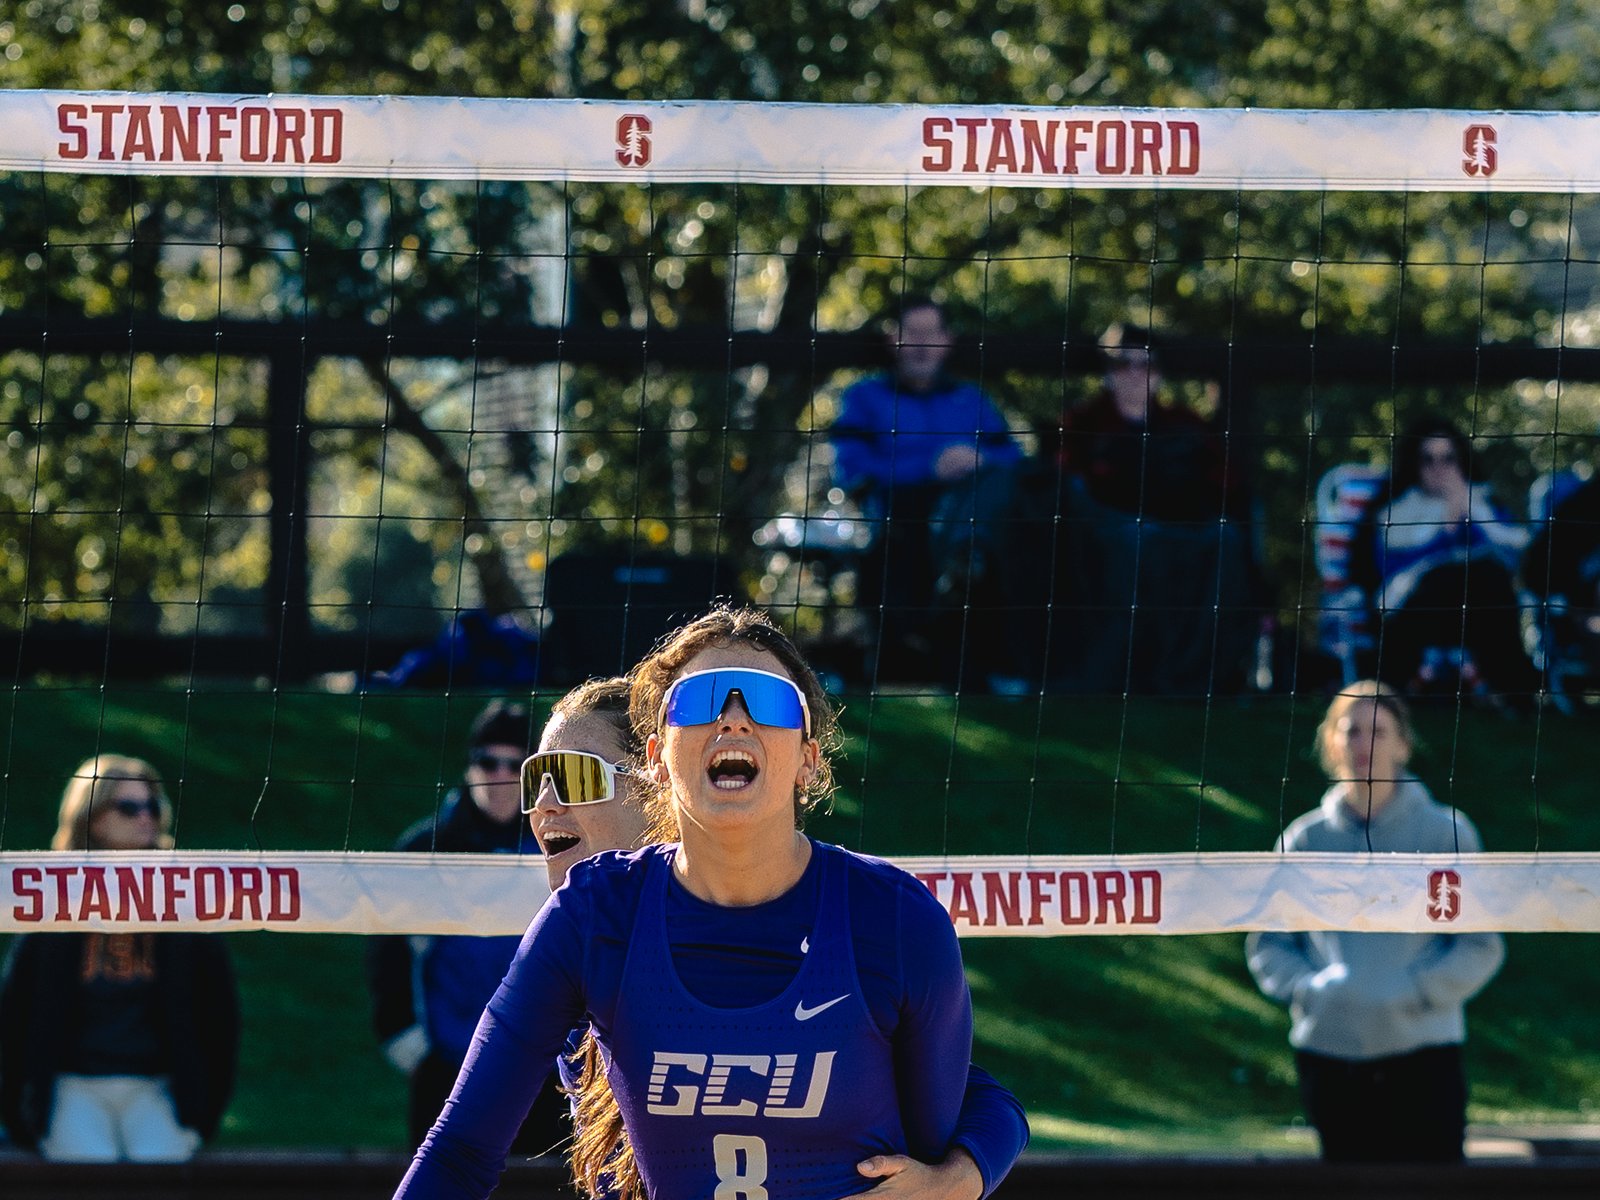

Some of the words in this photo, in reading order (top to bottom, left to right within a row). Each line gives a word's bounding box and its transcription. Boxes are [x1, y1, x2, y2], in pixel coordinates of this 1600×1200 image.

[57, 103, 343, 164] STANFORD
[922, 117, 1200, 175] STANFORD
[12, 866, 301, 922] STANFORD
[915, 870, 1162, 926] TANFORD
[647, 1050, 838, 1118] GCU
